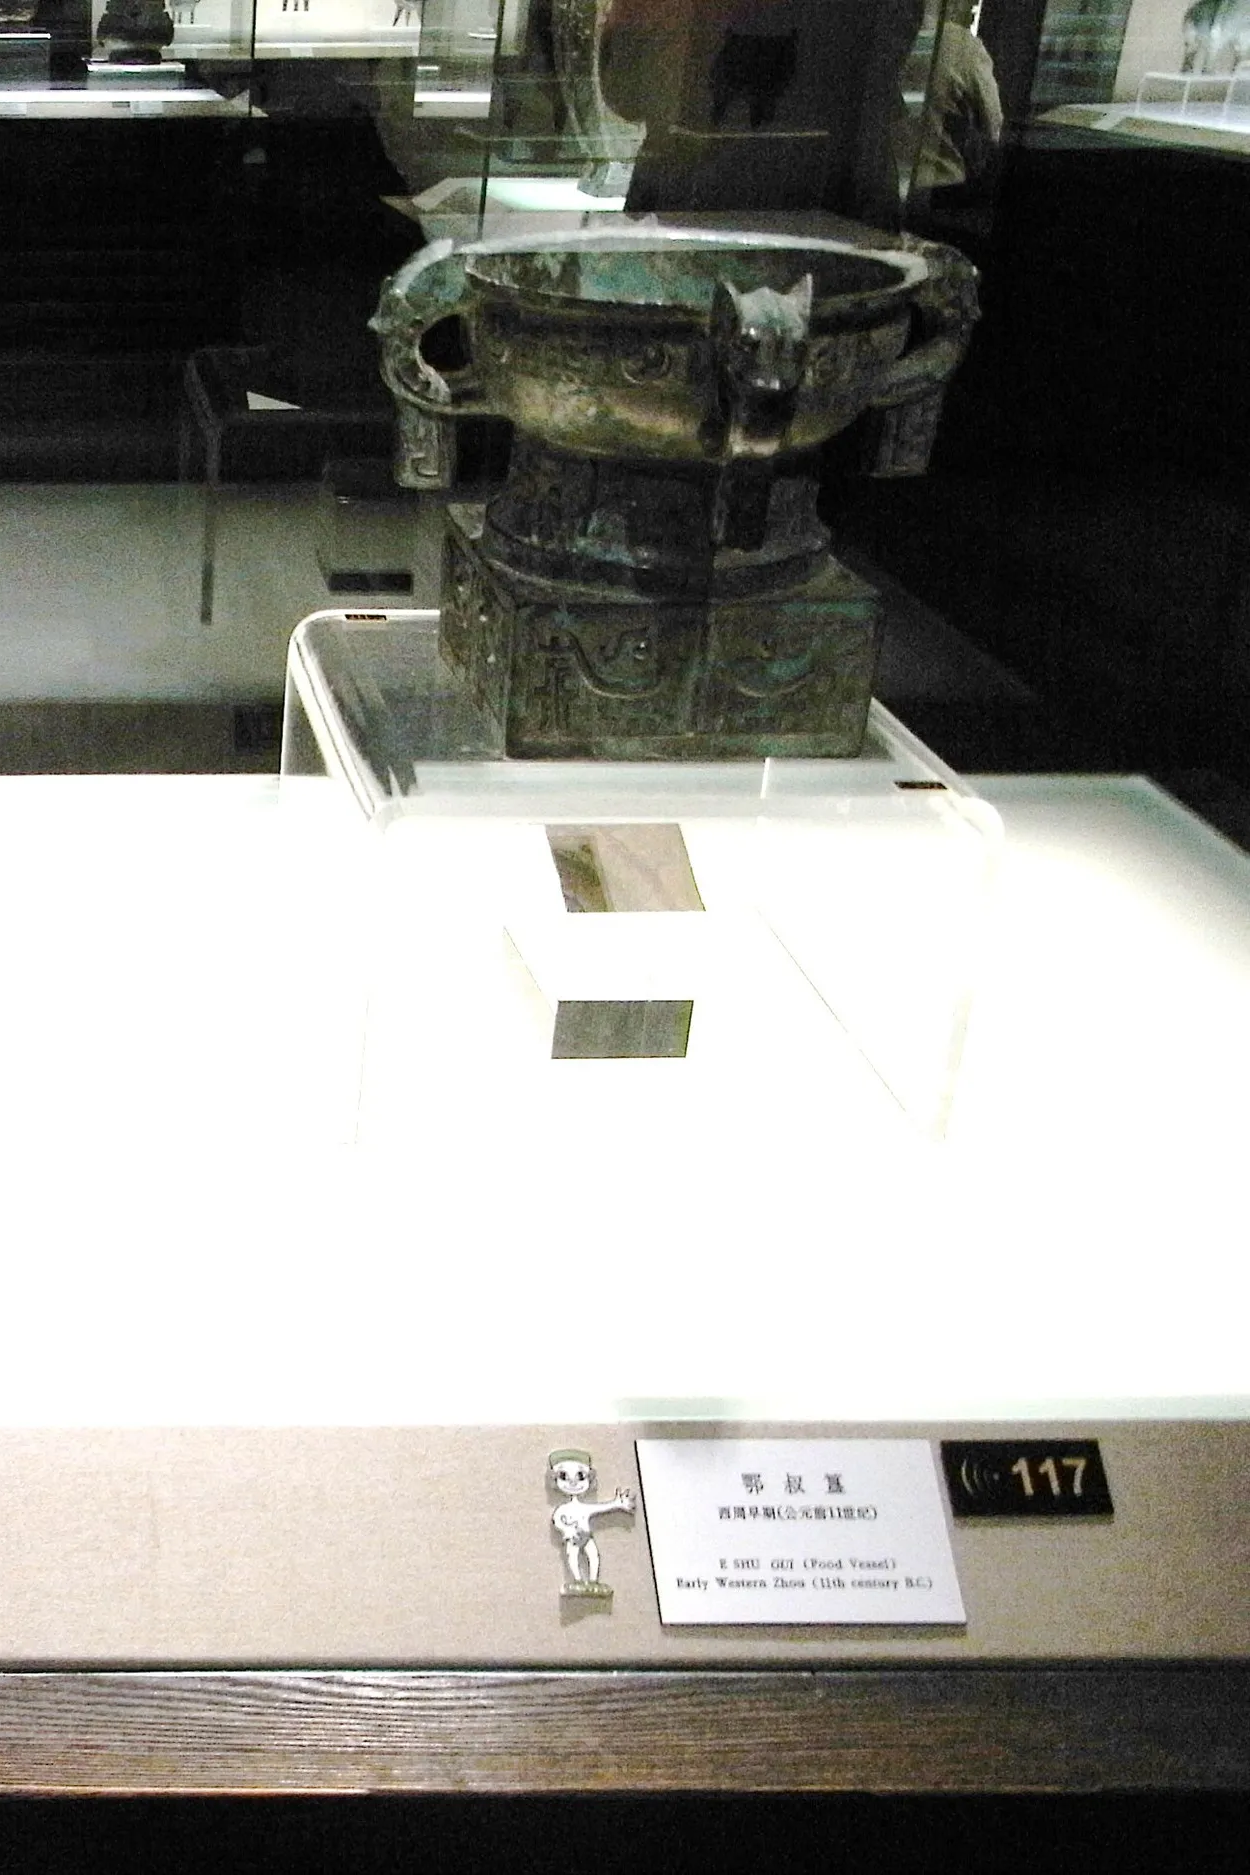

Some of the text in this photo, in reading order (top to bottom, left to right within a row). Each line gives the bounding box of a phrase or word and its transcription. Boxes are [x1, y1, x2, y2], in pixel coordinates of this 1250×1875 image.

[1011, 1457, 1087, 1496] 117
[733, 1558, 761, 1570] SHU
[770, 1558, 794, 1571] GUI
[802, 1557, 843, 1570] (Food
[849, 1557, 897, 1570] Vessel)
[675, 1577, 709, 1590] Early
[715, 1577, 768, 1589] Western
[773, 1577, 806, 1589] Zhou
[811, 1577, 846, 1590] (11th
[851, 1579, 898, 1591] century
